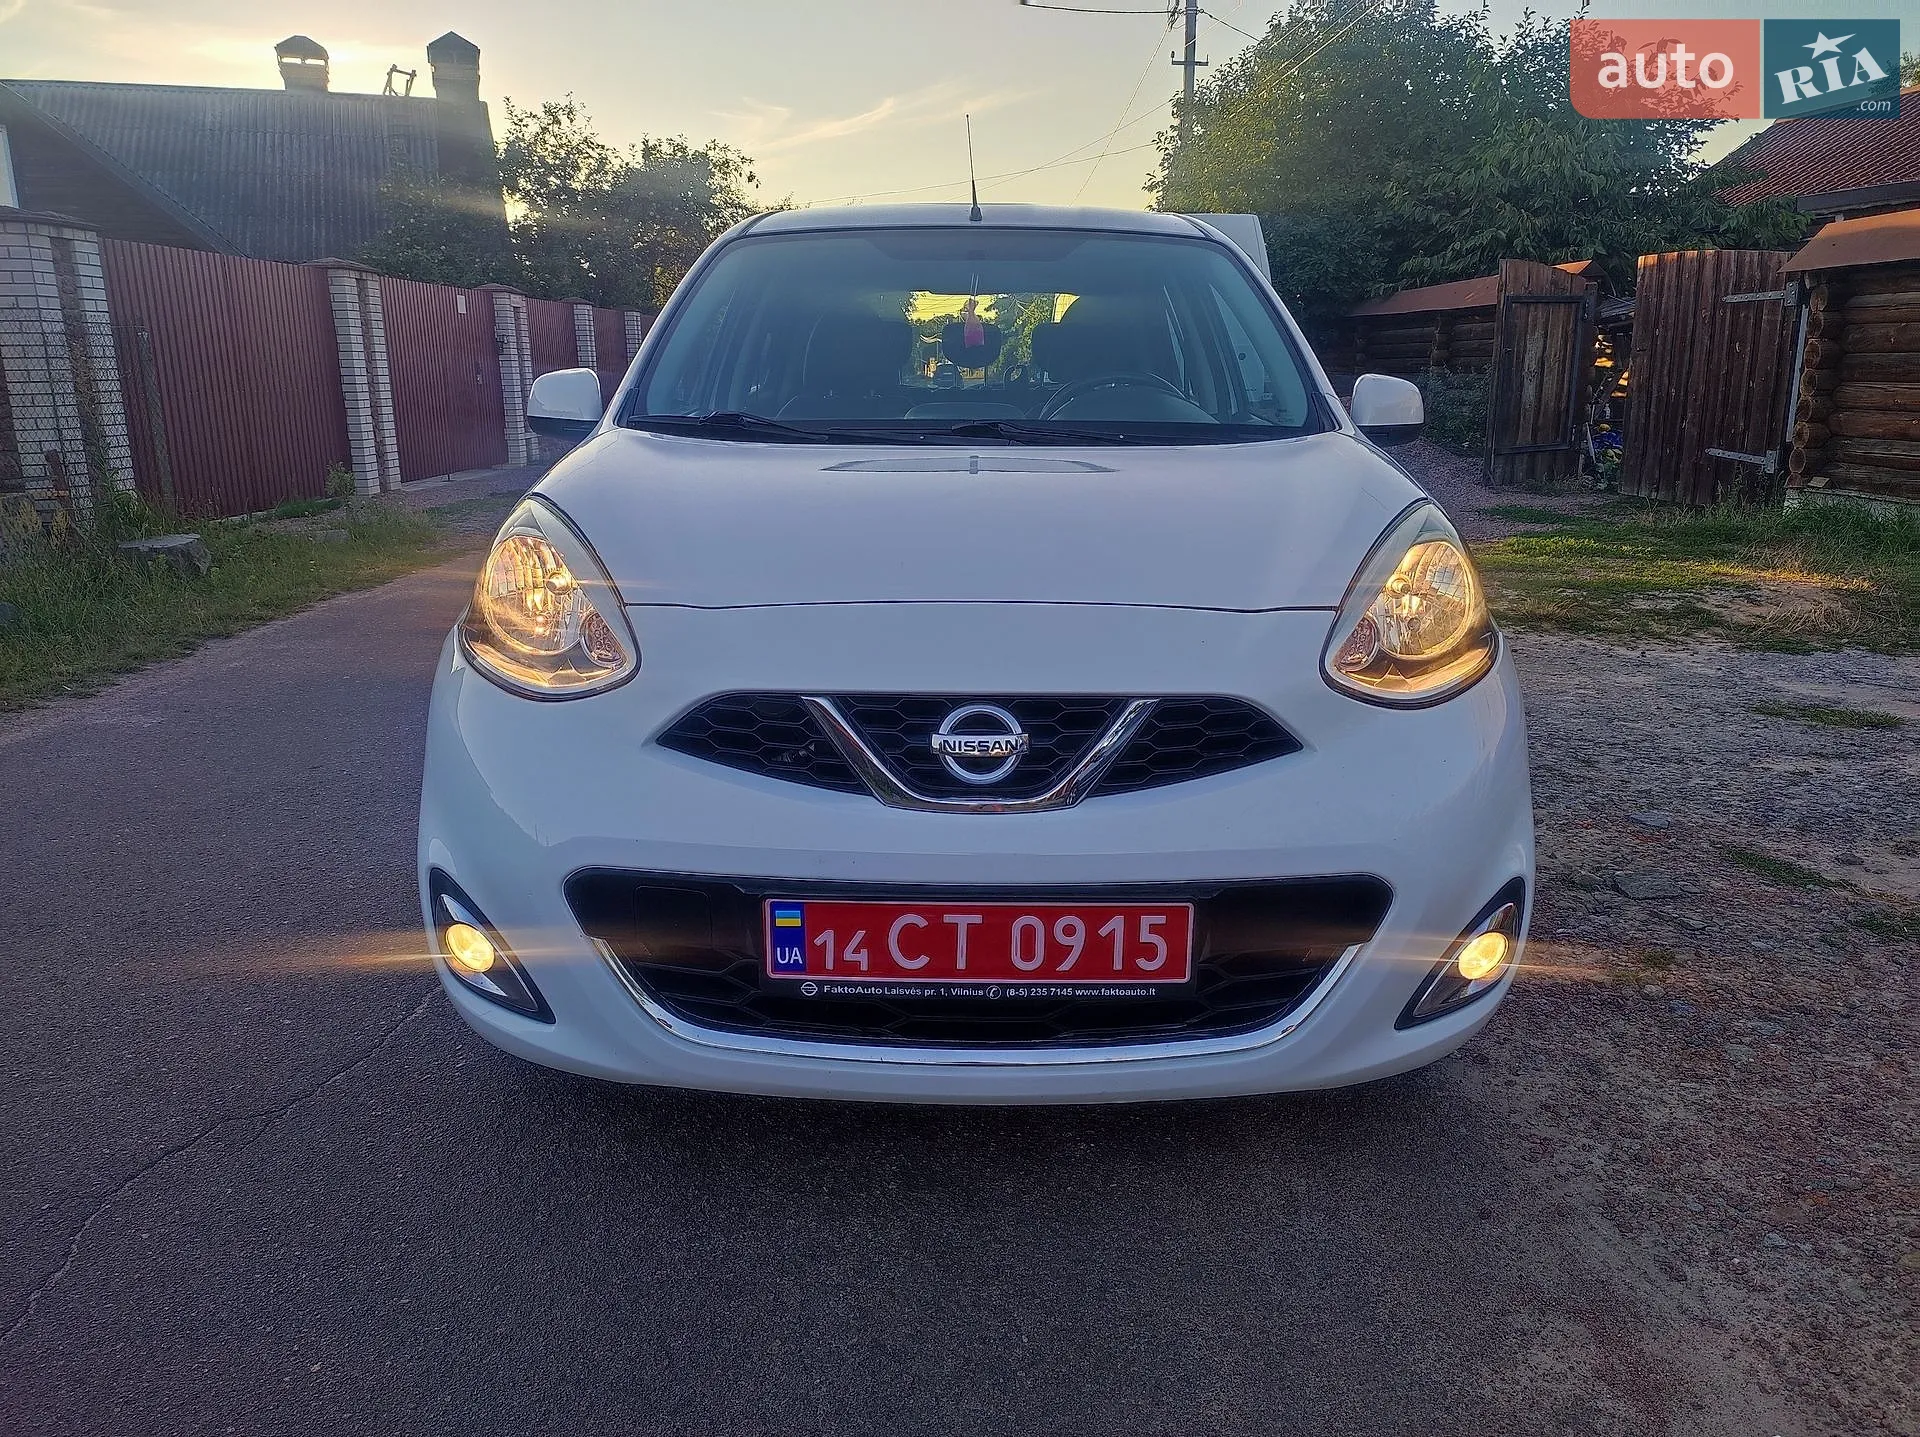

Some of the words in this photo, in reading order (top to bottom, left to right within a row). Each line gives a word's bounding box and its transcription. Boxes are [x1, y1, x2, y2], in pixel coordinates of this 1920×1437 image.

[941, 738, 1020, 753] NISSAN
[813, 929, 869, 971] 14
[887, 913, 984, 970] CT
[1010, 914, 1168, 972] 0915
[776, 946, 803, 965] UA
[823, 985, 883, 995] FaktoAuto
[924, 988, 937, 997] pr.
[950, 987, 984, 996] Vilnius
[1006, 988, 1028, 997] (8-5)
[1030, 988, 1048, 996] 235
[1050, 988, 1073, 996] 7145
[1075, 987, 1156, 996] www.faktoauto.lt
